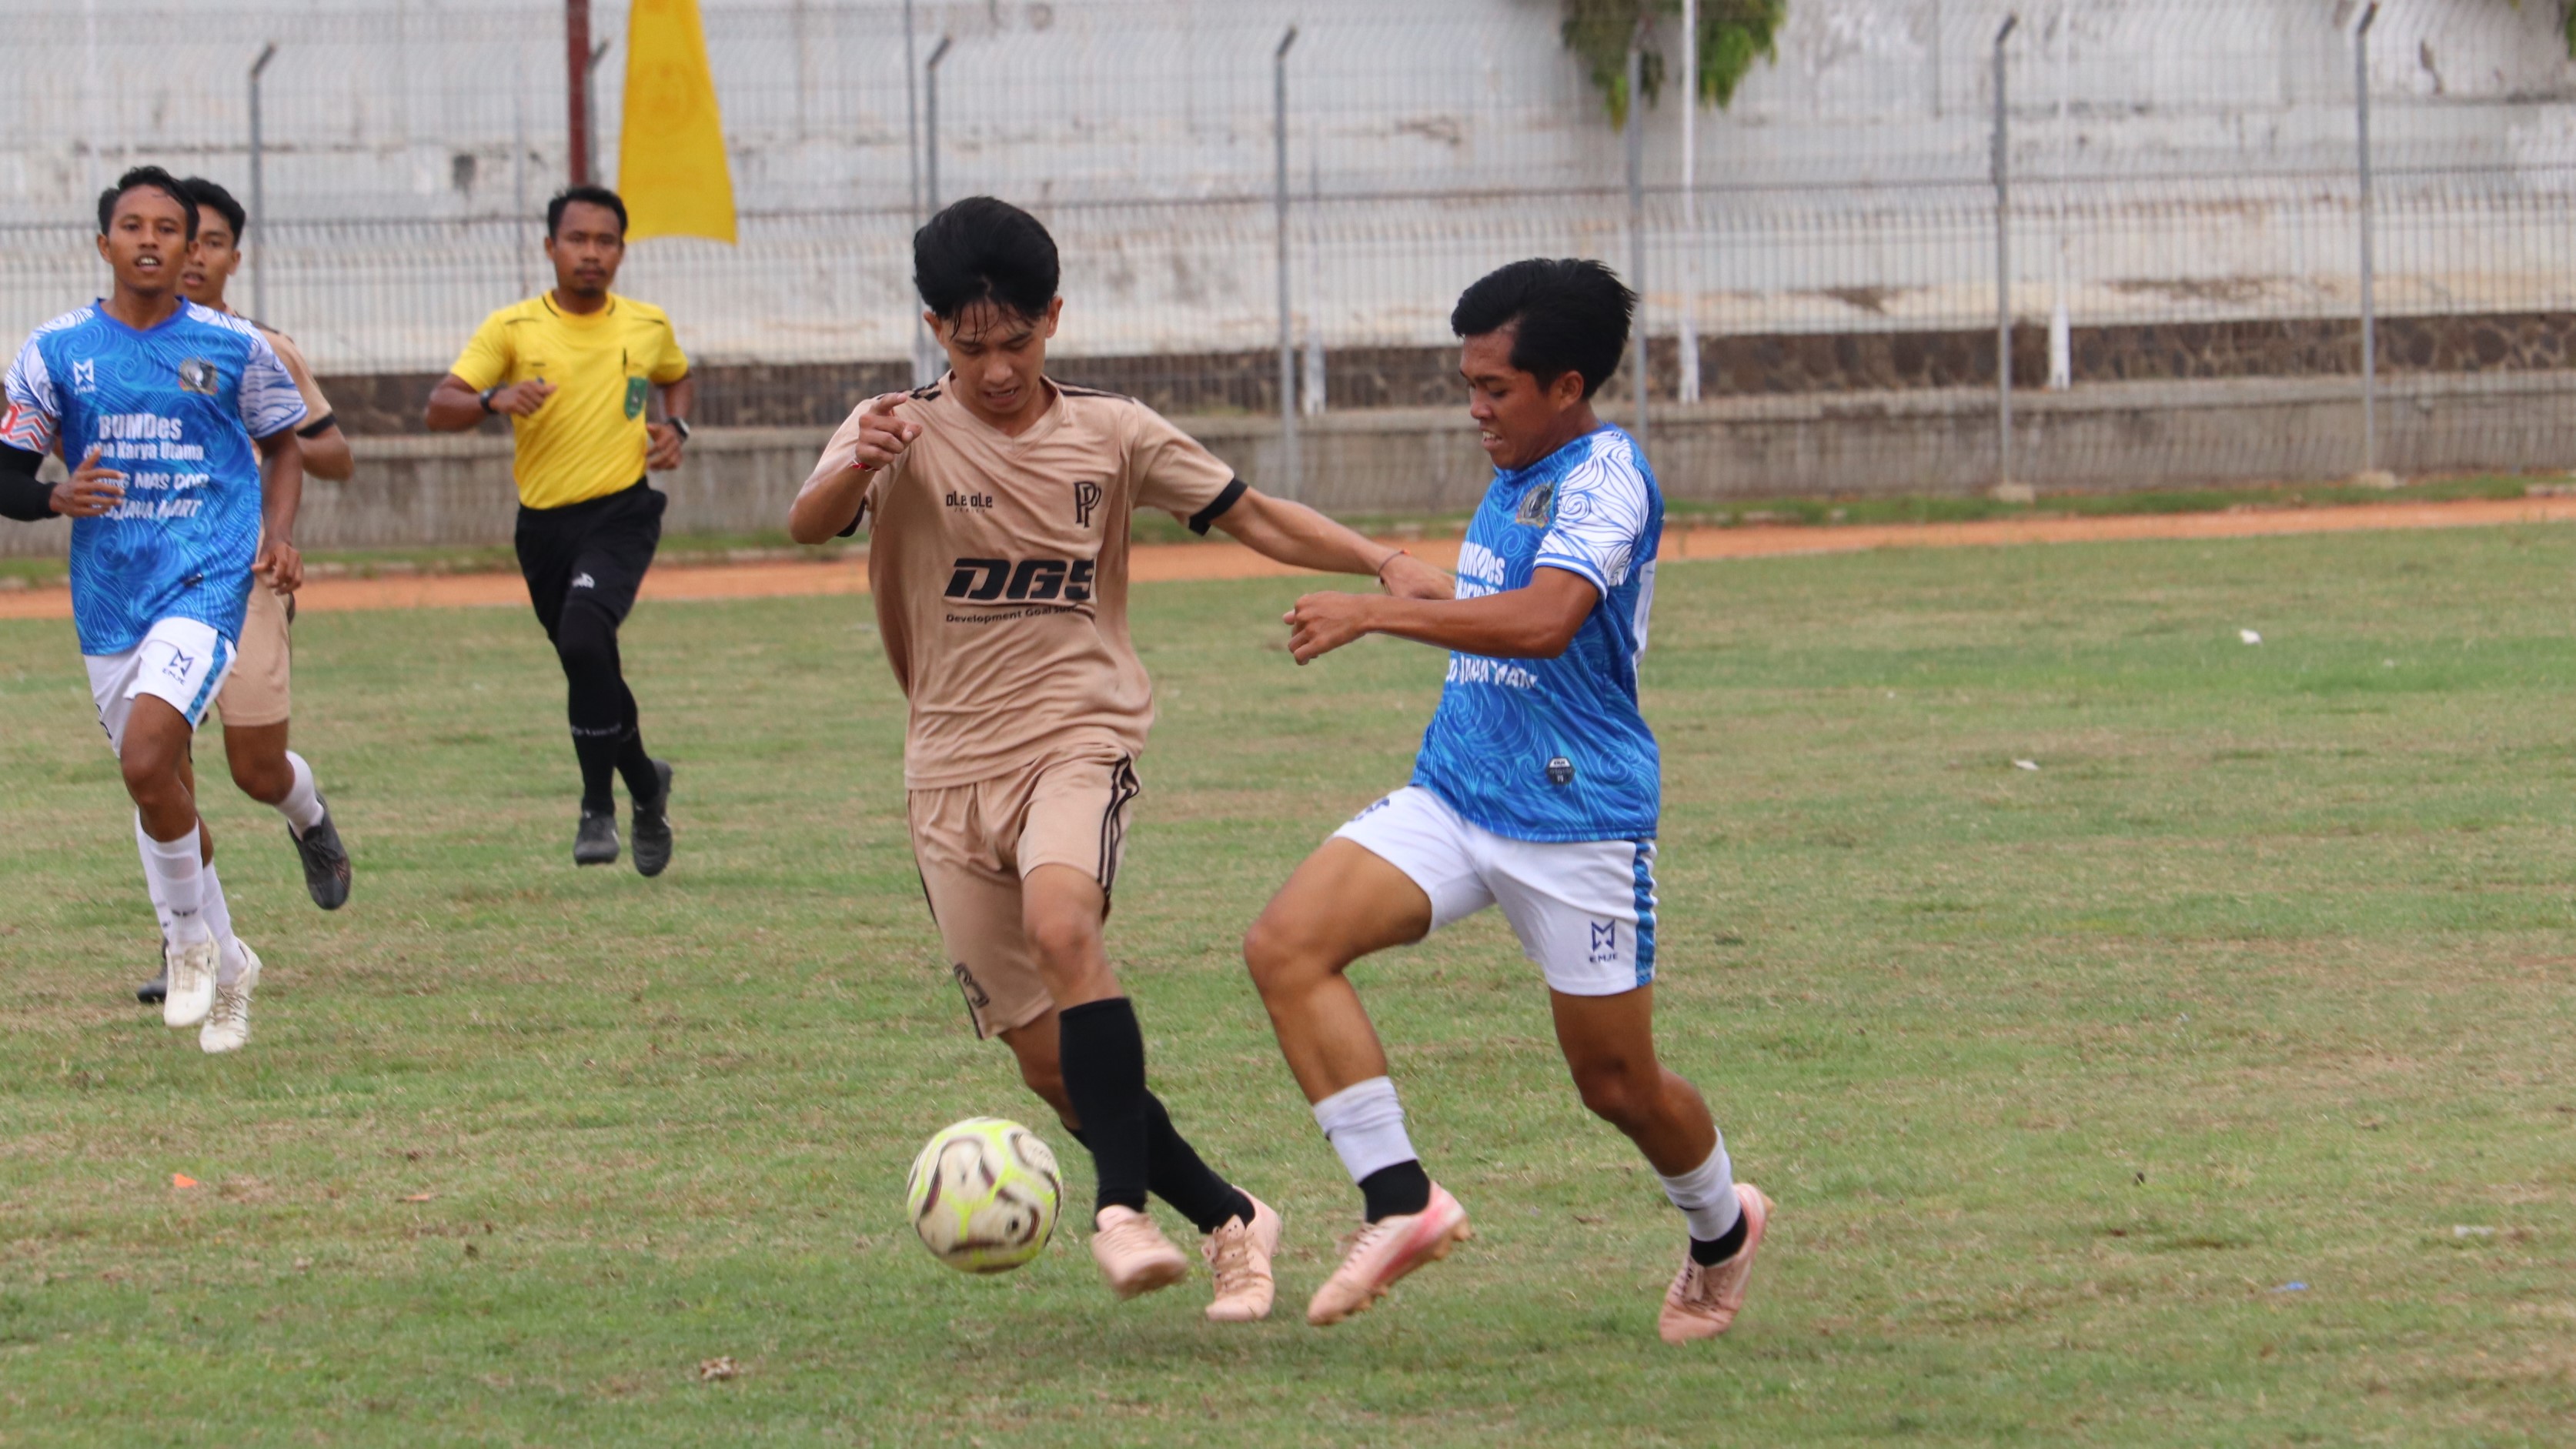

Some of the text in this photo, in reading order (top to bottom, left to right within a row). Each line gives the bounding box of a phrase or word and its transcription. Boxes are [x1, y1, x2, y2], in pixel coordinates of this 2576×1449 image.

[99, 412, 182, 440] BUMDes
[117, 441, 157, 461] Karya
[159, 441, 204, 461] Utama
[946, 611, 1022, 624] Development
[1026, 606, 1052, 617] Goal
